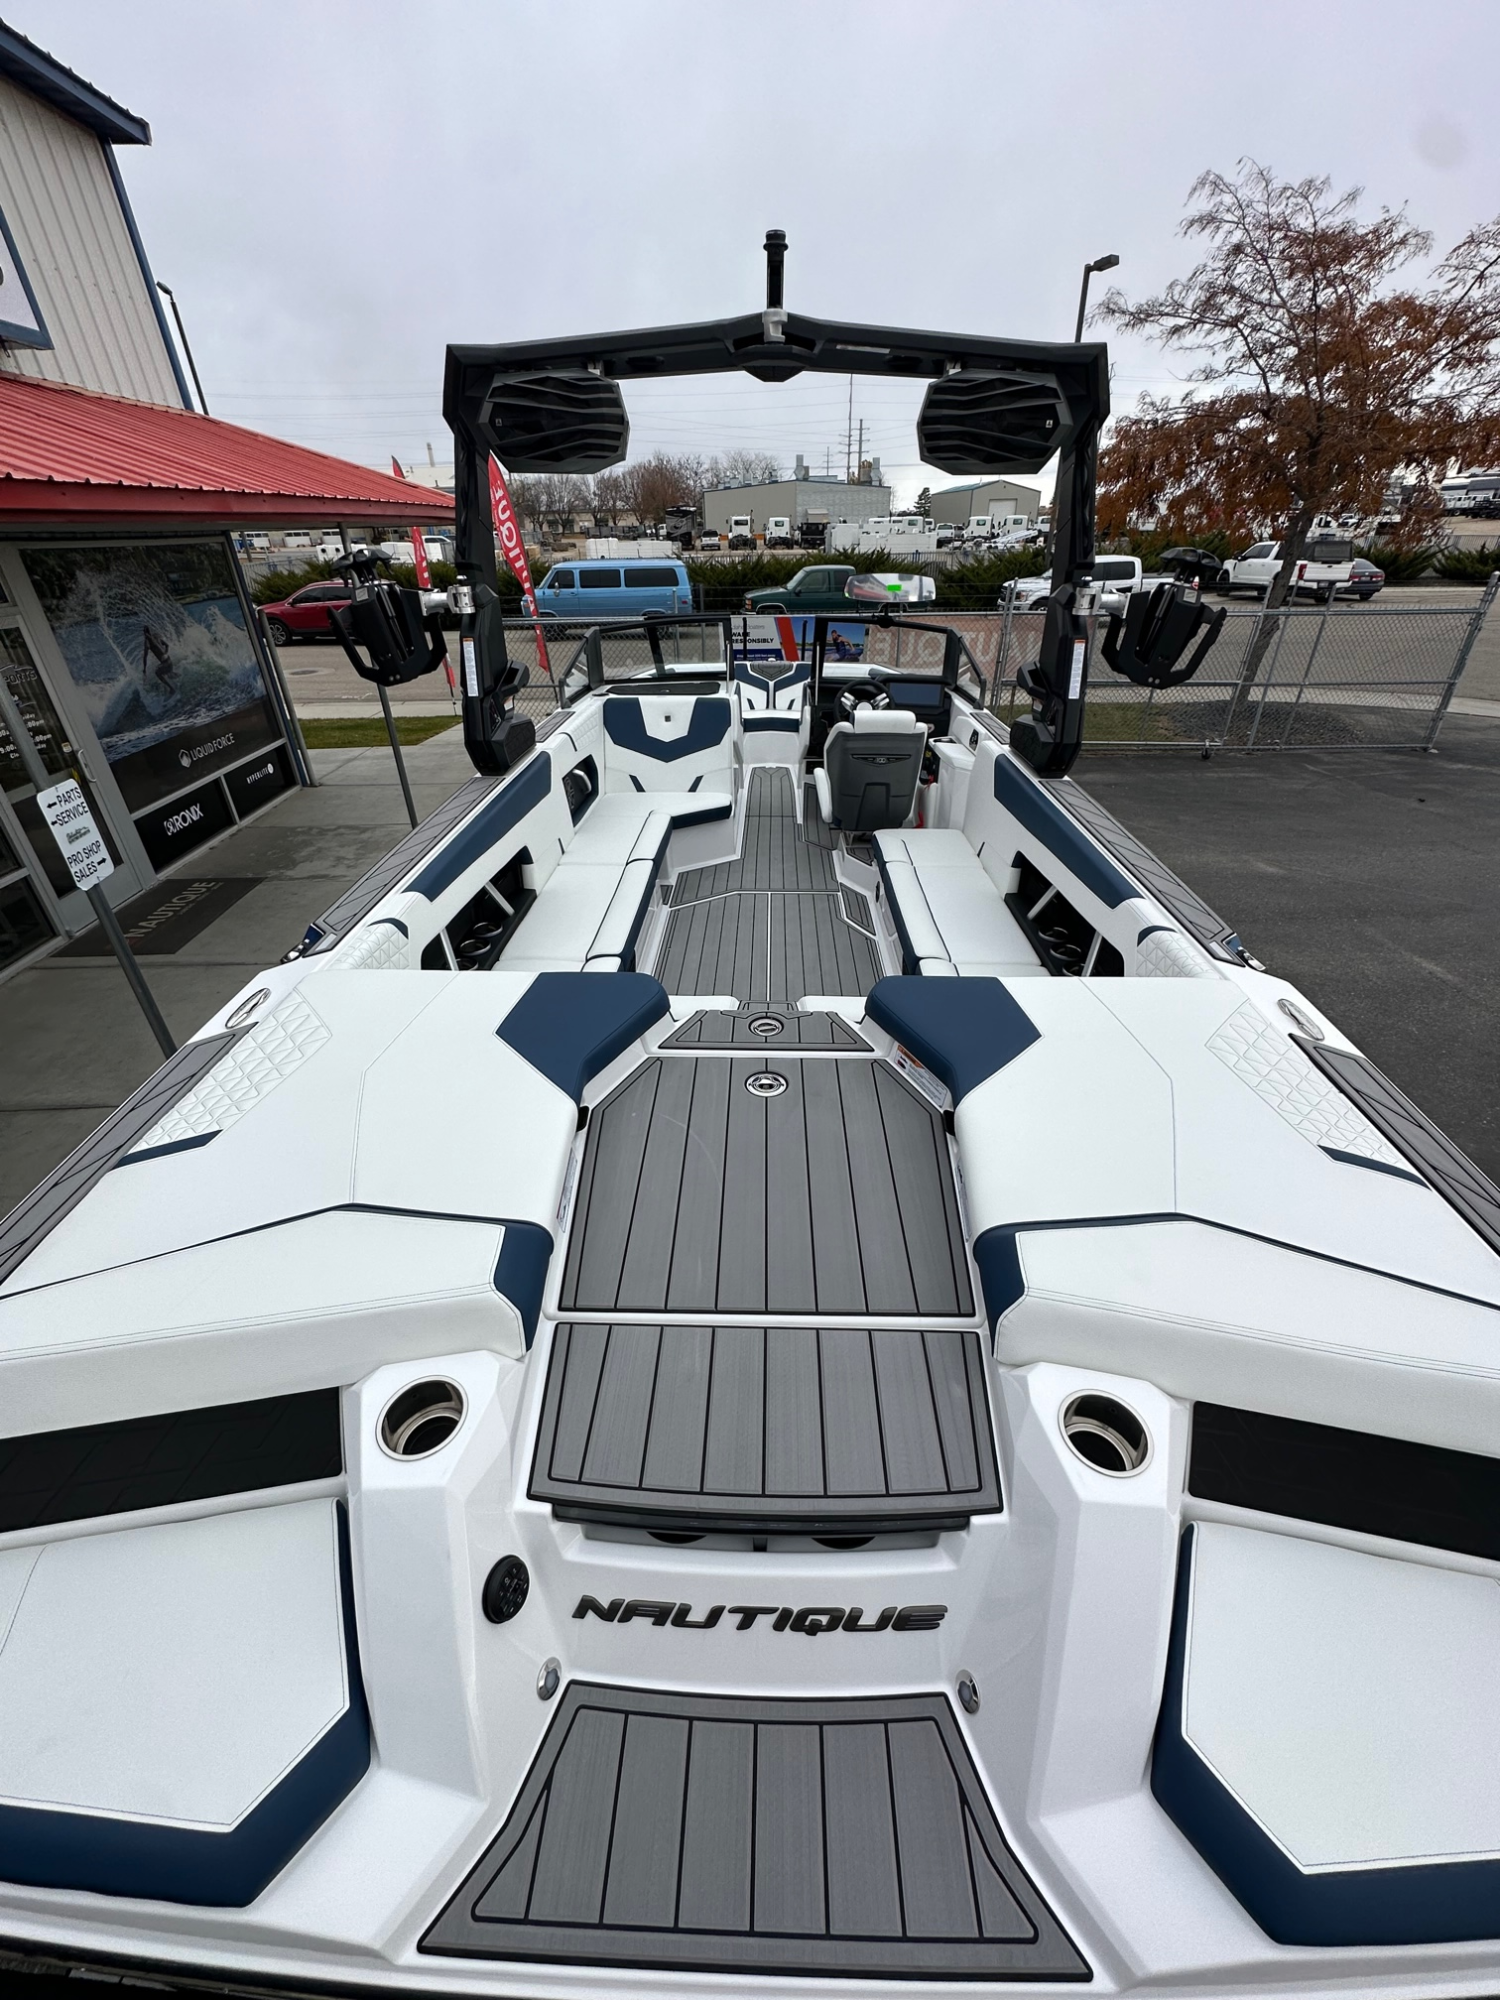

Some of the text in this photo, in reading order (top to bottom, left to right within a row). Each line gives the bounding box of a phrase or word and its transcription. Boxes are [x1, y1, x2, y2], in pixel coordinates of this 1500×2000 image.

[3, 670, 38, 685] PORTS
[190, 732, 236, 761] LIQUID FORCE
[56, 786, 82, 808] PARTS
[55, 801, 89, 827] SERVICE
[173, 803, 204, 831] RONIX
[66, 840, 102, 869] PRO SHOP
[74, 860, 98, 883] SALES
[124, 881, 217, 938] NAUTIQUE
[572, 1594, 948, 1636] NAUTIQUE
